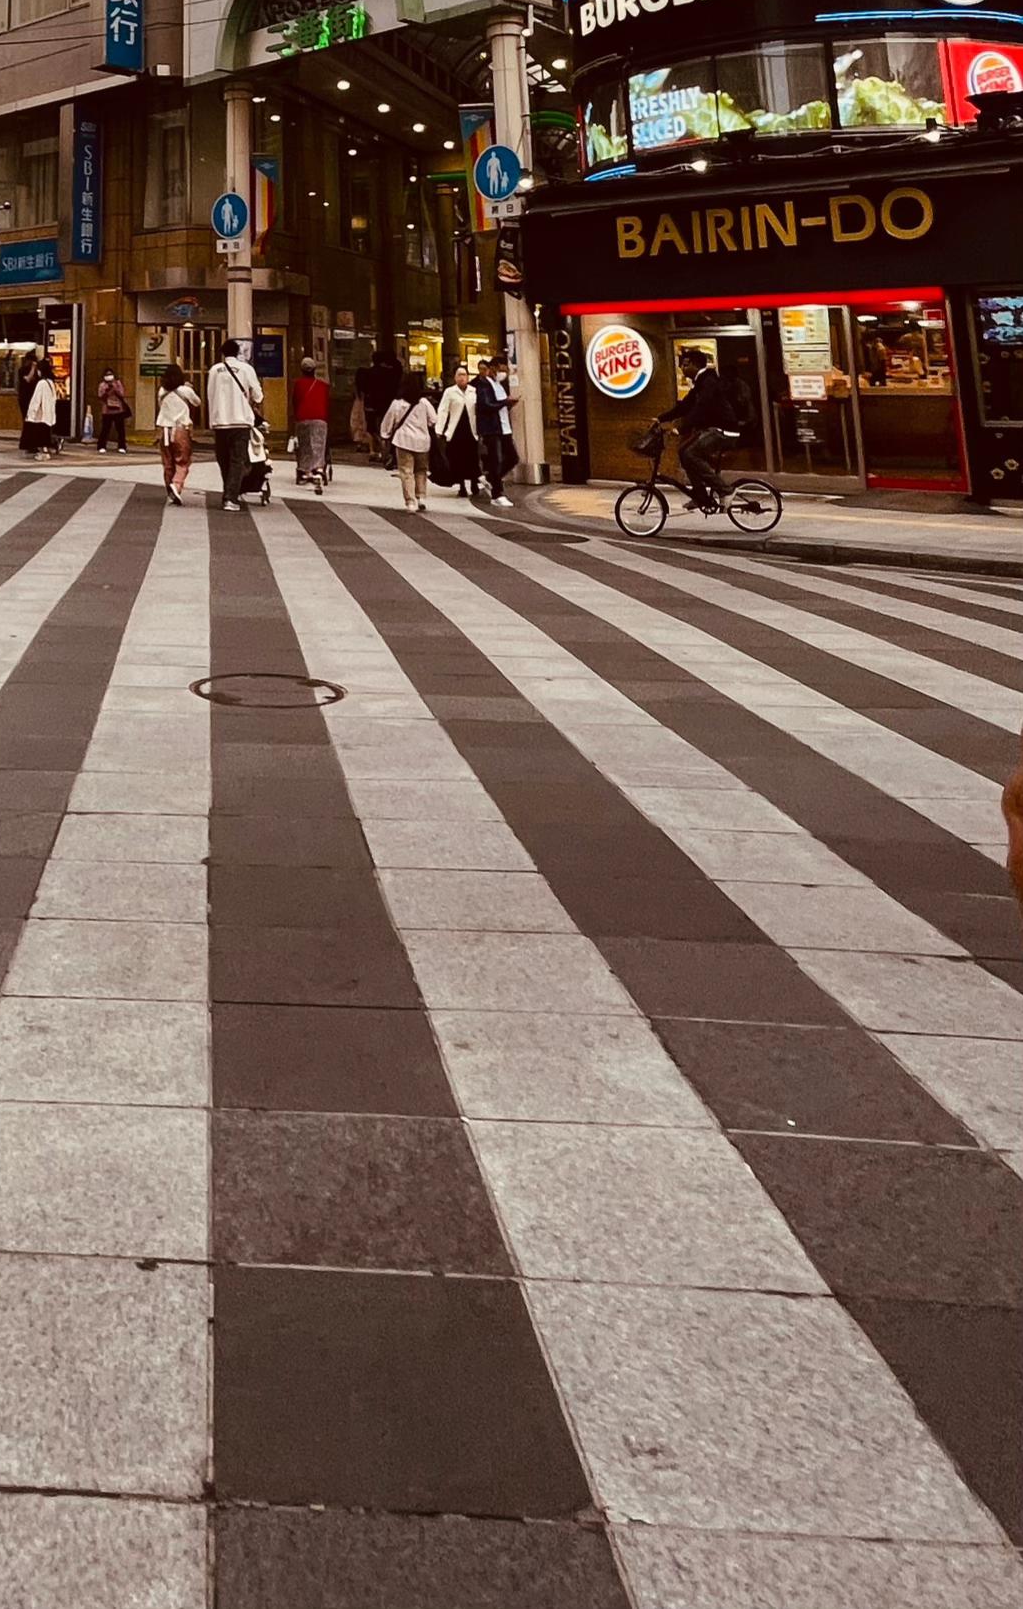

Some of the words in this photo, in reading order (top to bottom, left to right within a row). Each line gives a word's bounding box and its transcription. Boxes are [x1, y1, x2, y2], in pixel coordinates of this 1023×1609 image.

[976, 66, 1011, 86] BURGER
[631, 86, 701, 122] FRESHLY
[616, 187, 934, 260] BAIRIN-DO
[594, 340, 640, 364] BURGER
[596, 352, 642, 380] KING
